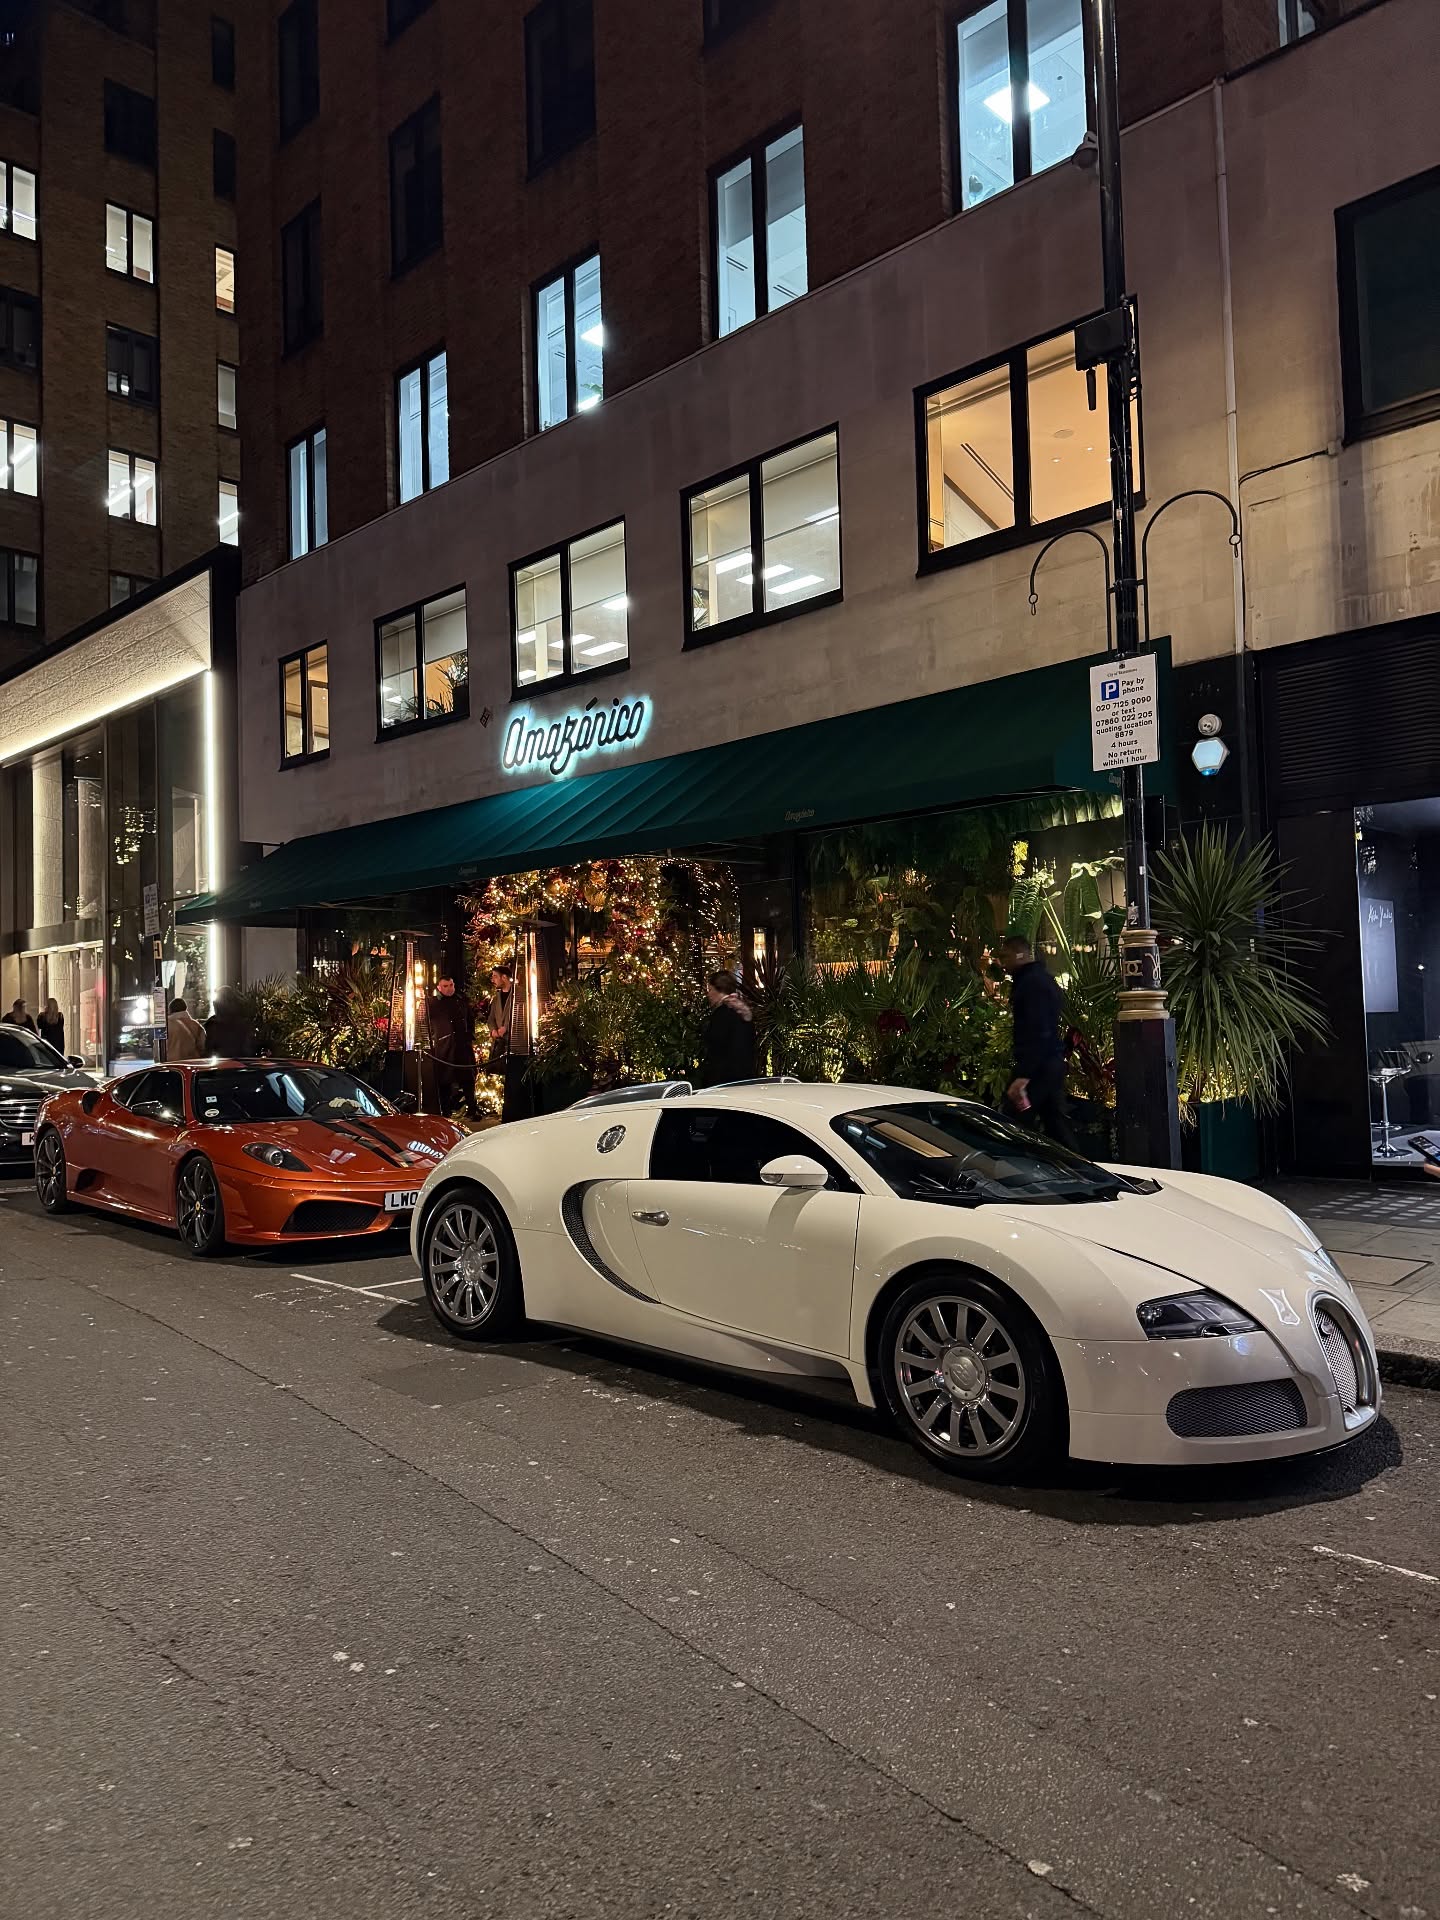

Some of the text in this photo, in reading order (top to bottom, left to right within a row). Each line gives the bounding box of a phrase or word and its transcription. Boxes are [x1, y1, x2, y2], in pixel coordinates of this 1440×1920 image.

[1136, 677, 1145, 685] by
[1105, 682, 1117, 699] P
[1122, 685, 1144, 695] phone
[1095, 695, 1152, 712] 020 7125 9090
[1121, 706, 1136, 715] text
[1121, 714, 1136, 722] 022
[1137, 710, 1153, 719] 205
[1096, 719, 1153, 735] quoting location
[503, 697, 645, 775] Amazónico
[1118, 739, 1138, 747] hours
[1120, 748, 1142, 756] return
[1102, 758, 1124, 767] within
